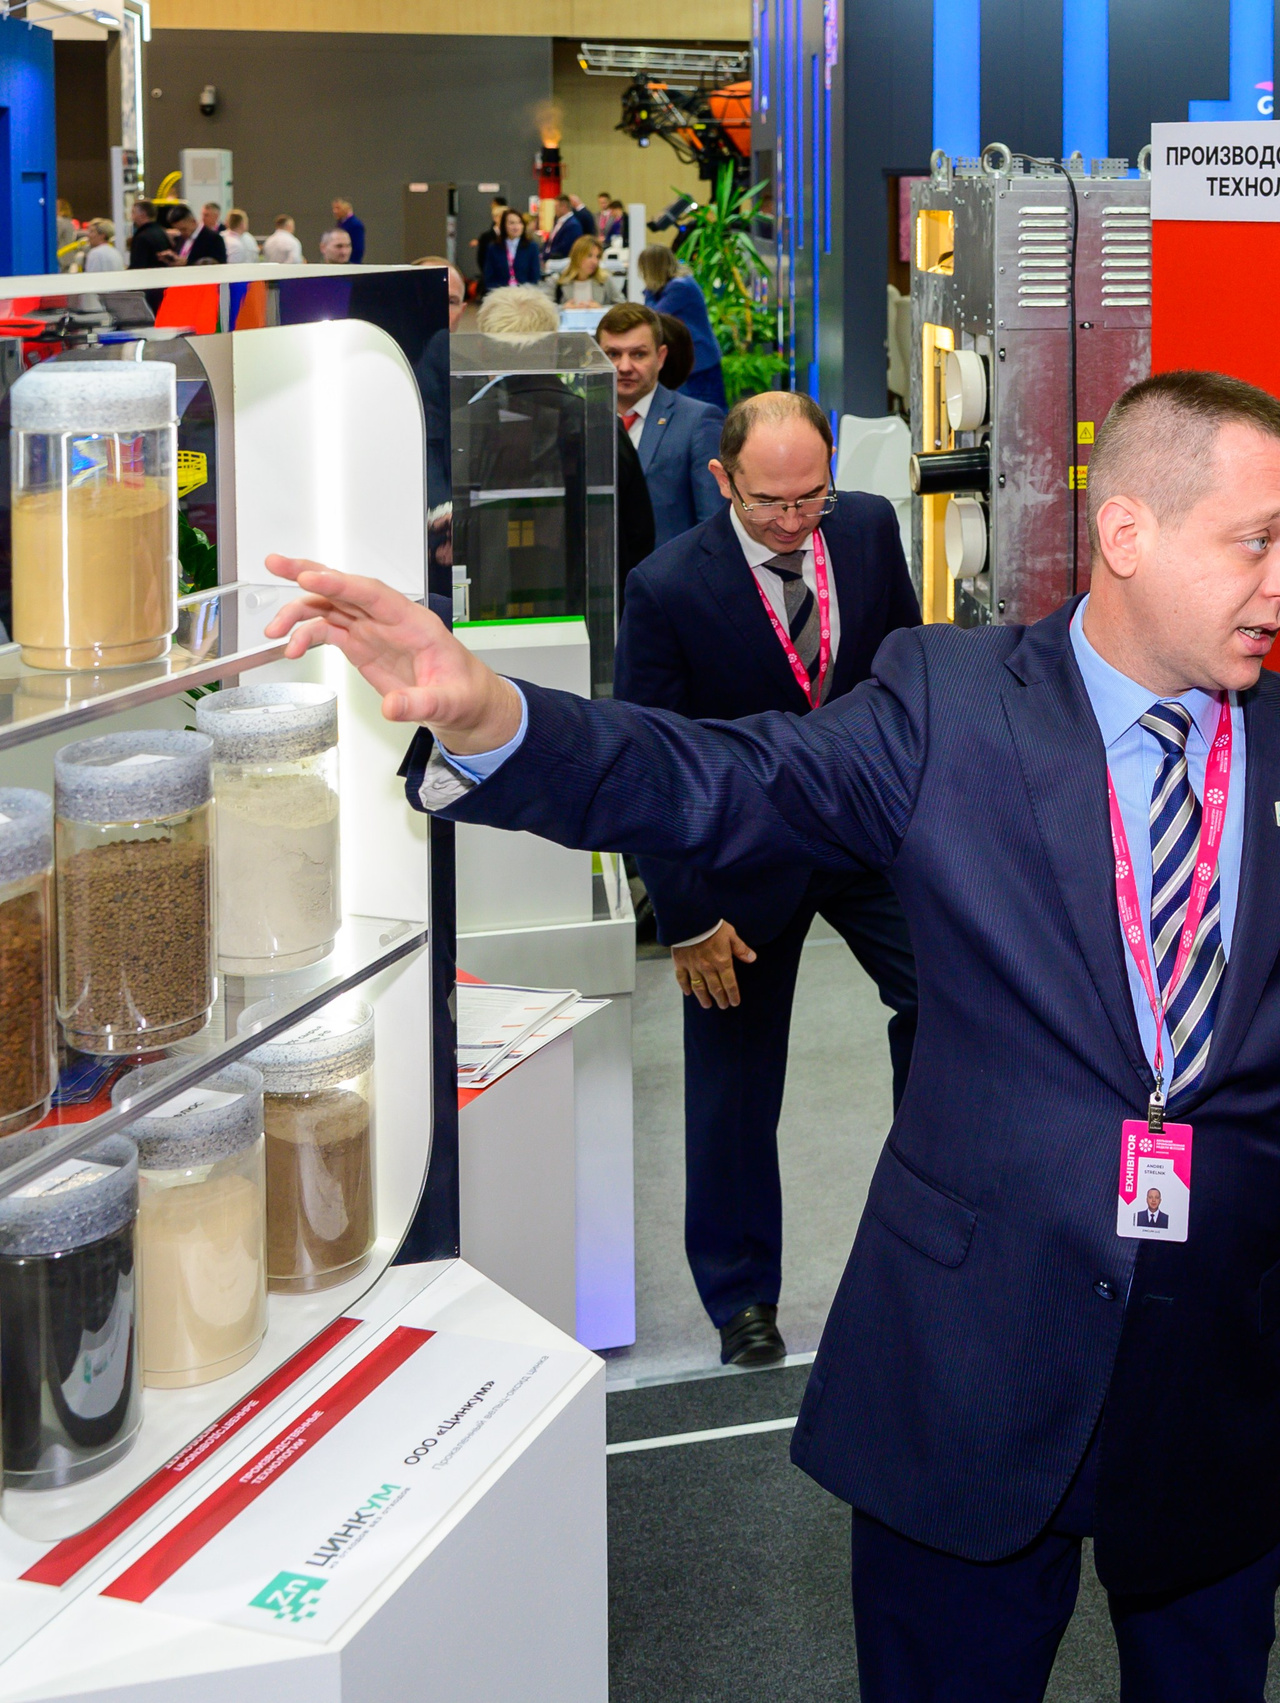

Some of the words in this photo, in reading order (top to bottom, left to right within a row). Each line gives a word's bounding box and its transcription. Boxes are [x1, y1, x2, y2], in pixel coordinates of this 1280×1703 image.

[1125, 1134, 1136, 1193] EXHIBITOR
[238, 1410, 325, 1484] ПРОИЗВОДСТВЕННЫЕ
[404, 1438, 438, 1465] ООО
[436, 1380, 495, 1436] «Цинкум»
[251, 1438, 307, 1485] ТЕХНОЛОГИИ
[305, 1483, 401, 1567] ЦИНКУМ
[265, 1579, 309, 1607] Zn
